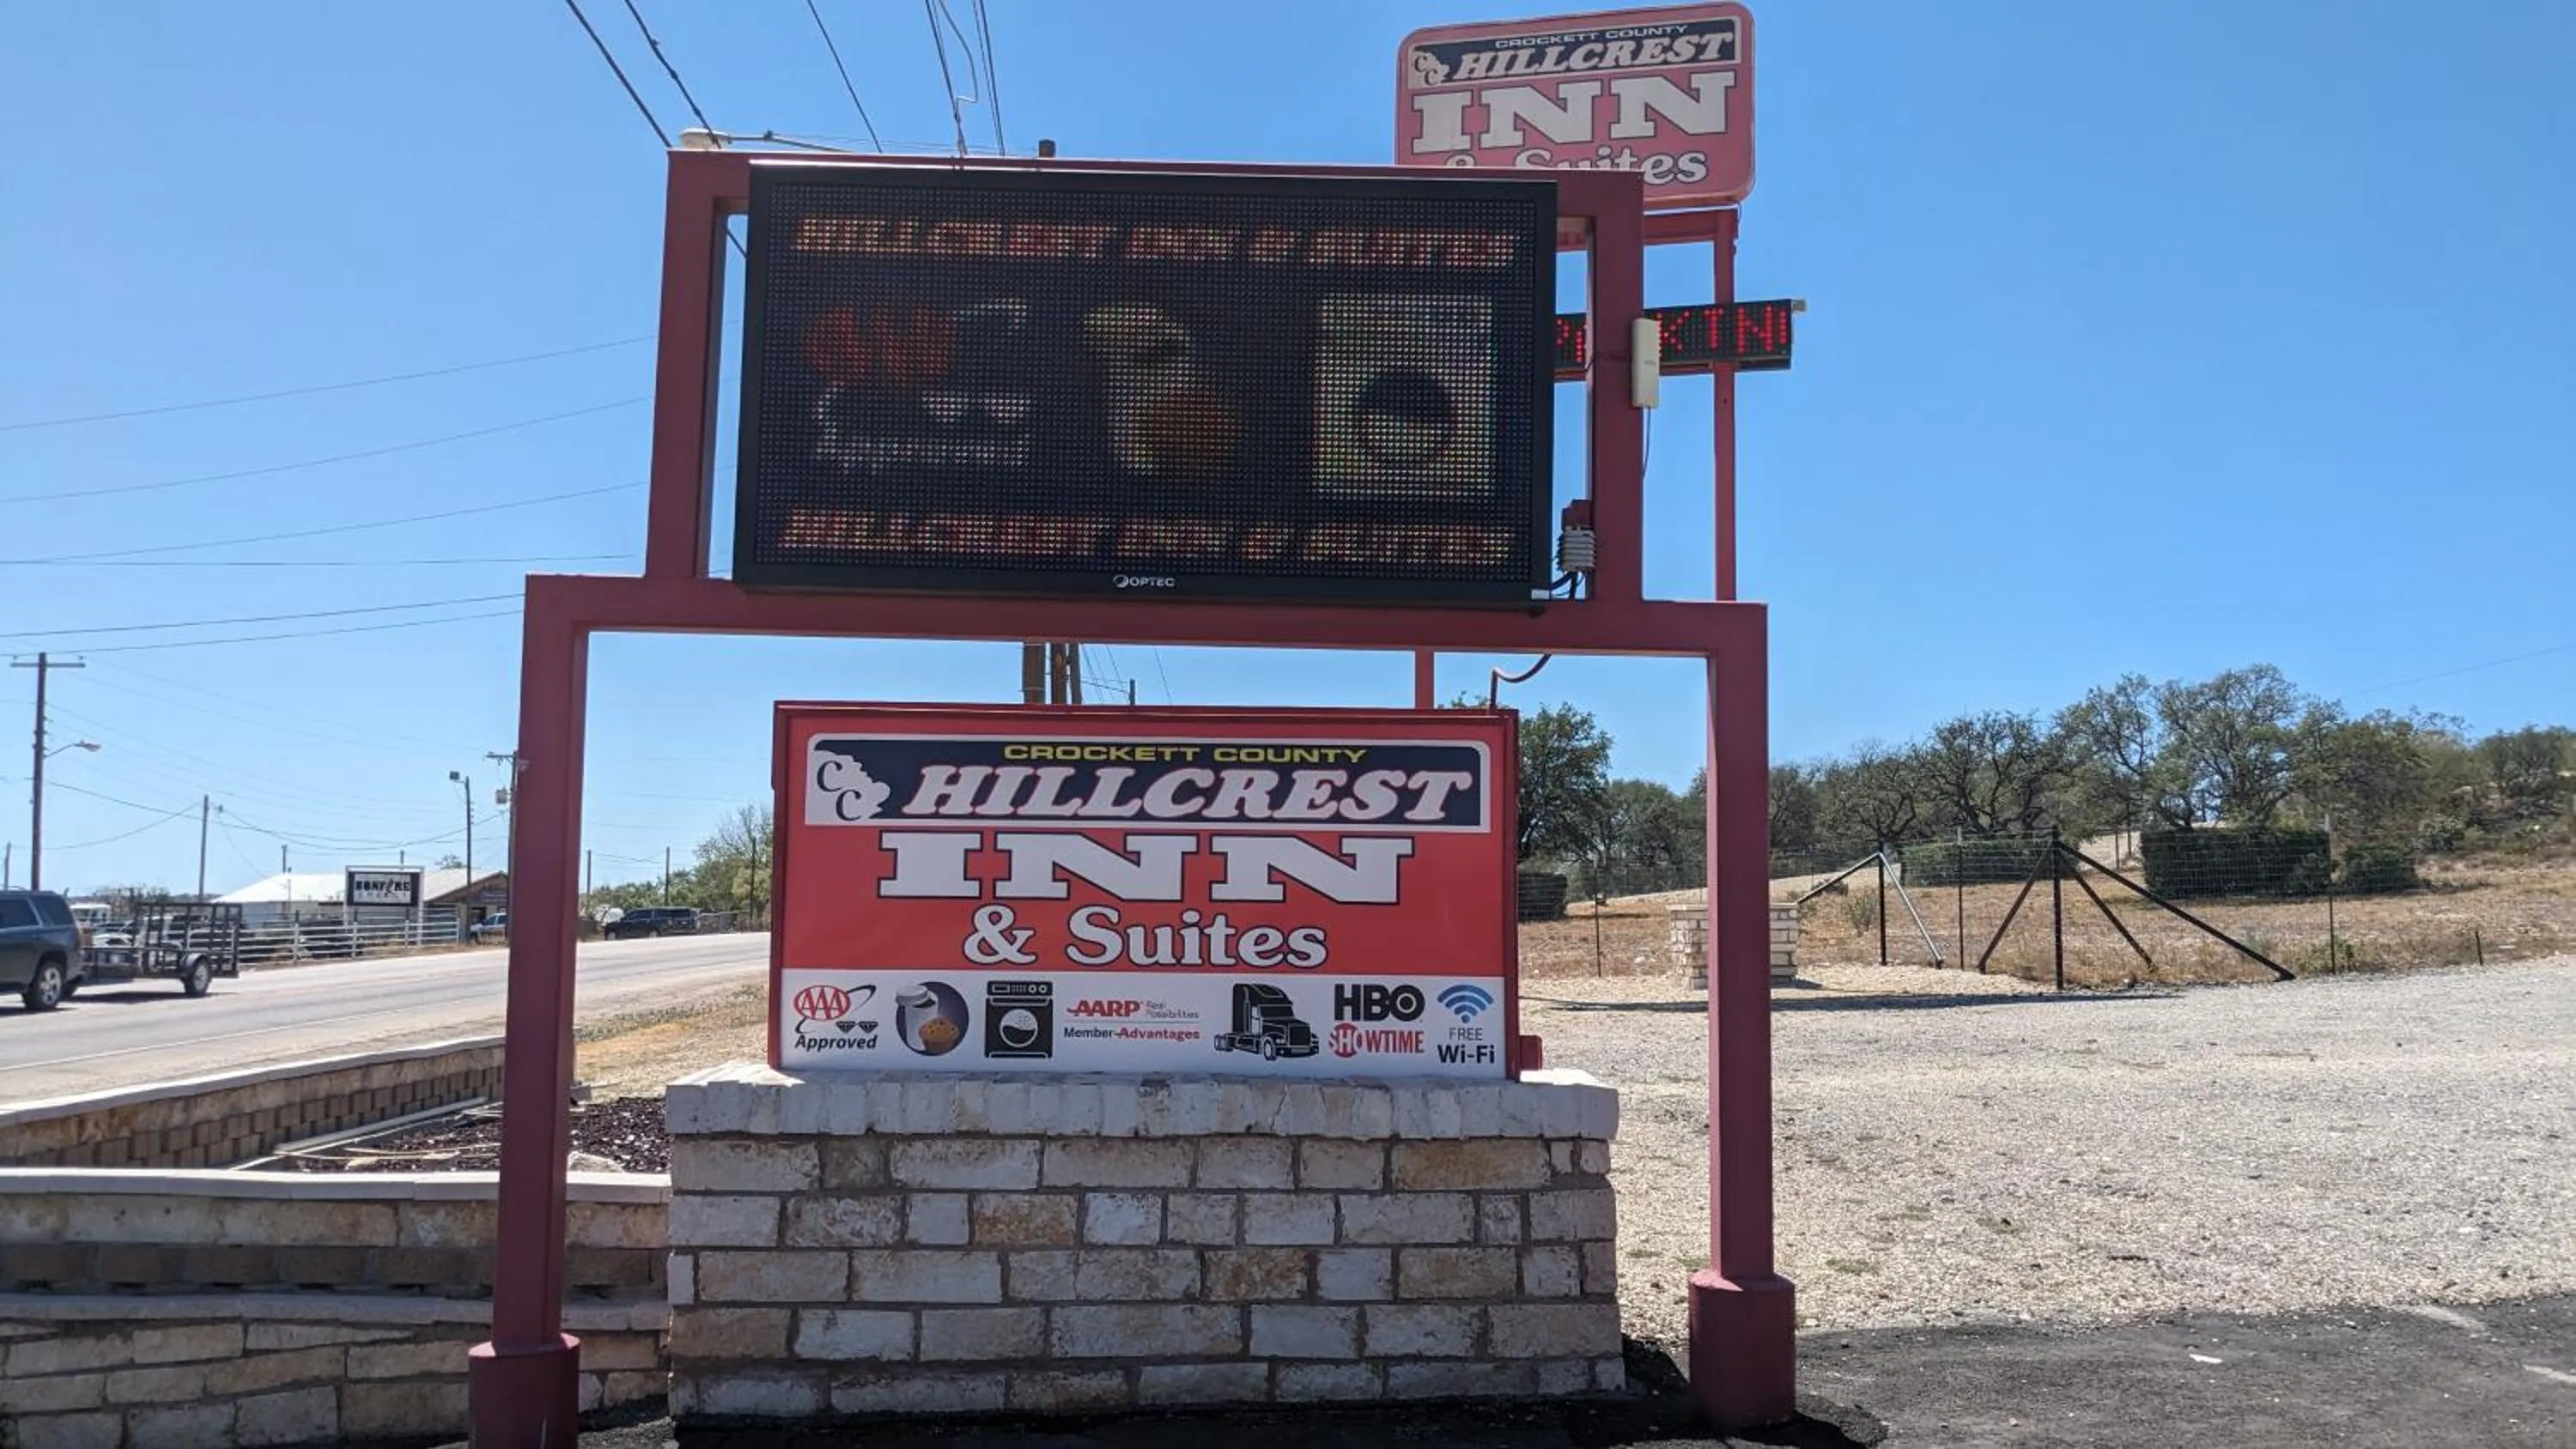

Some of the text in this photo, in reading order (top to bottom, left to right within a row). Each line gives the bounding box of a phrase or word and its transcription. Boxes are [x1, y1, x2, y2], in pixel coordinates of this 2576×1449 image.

[1495, 24, 1688, 48] CROCKETT COUNTY
[1451, 31, 1735, 81] HILLCREST
[1412, 70, 1736, 155] INN
[1129, 576, 1176, 587] OPTEC
[1003, 744, 1369, 764] CROCKETT COUNTY
[902, 764, 1473, 822] HILLCREST
[878, 830, 1415, 905] INN
[963, 904, 1328, 968] & Suites
[795, 985, 849, 1021] AAA
[1066, 999, 1141, 1017] AARP
[1334, 984, 1426, 1022] HBO
[794, 1034, 878, 1052] Approved
[1063, 1027, 1201, 1042] Member Advantages
[1328, 1024, 1425, 1058] SHOWTIME
[1449, 1027, 1483, 1041] FREE
[1437, 1044, 1496, 1064] Wi-Fi
